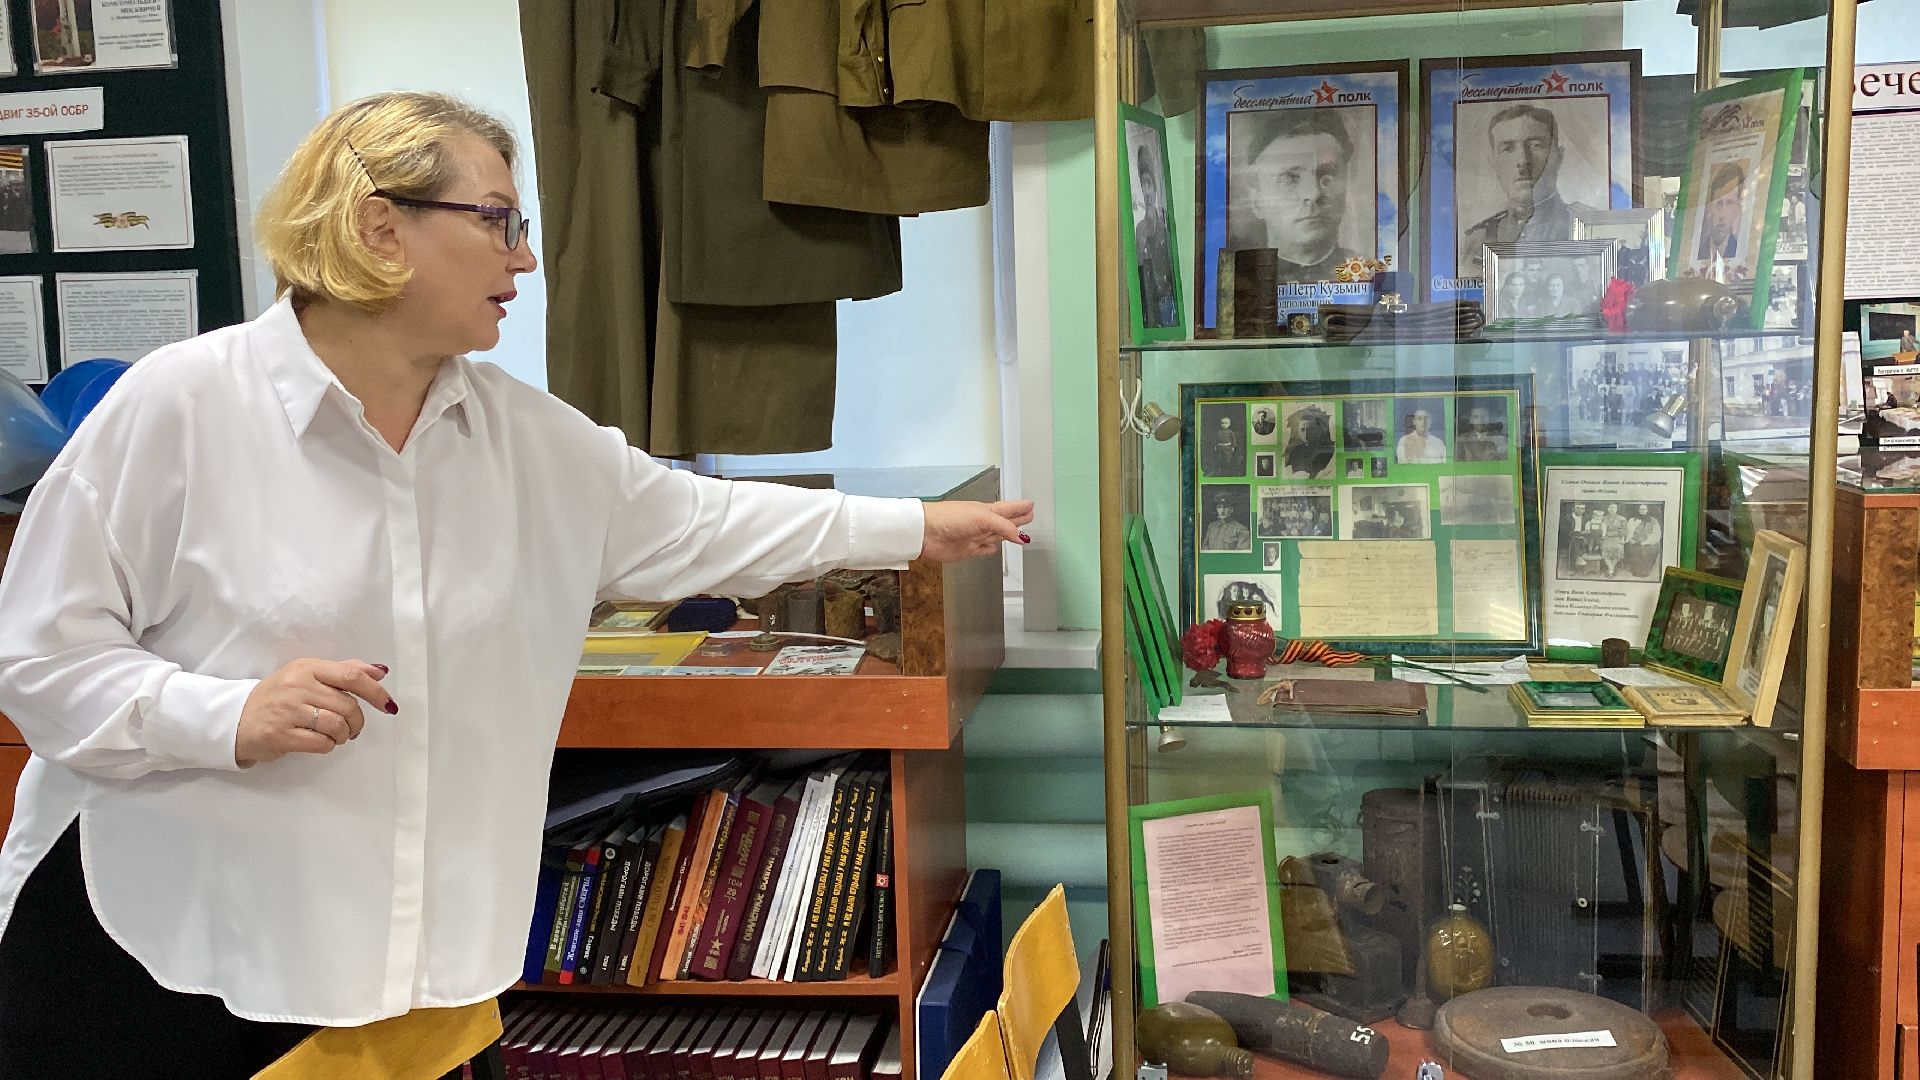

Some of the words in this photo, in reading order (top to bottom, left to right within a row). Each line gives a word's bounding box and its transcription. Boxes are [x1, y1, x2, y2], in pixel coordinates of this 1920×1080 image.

[1852, 71, 1920, 97] ече
[26, 104, 58, 118] 35-ОЙ
[61, 104, 88, 116] ОСБР
[1289, 282, 1317, 298] Петр
[1320, 280, 1368, 298] Кузьмич
[610, 900, 622, 931] ПОБЕДЫ
